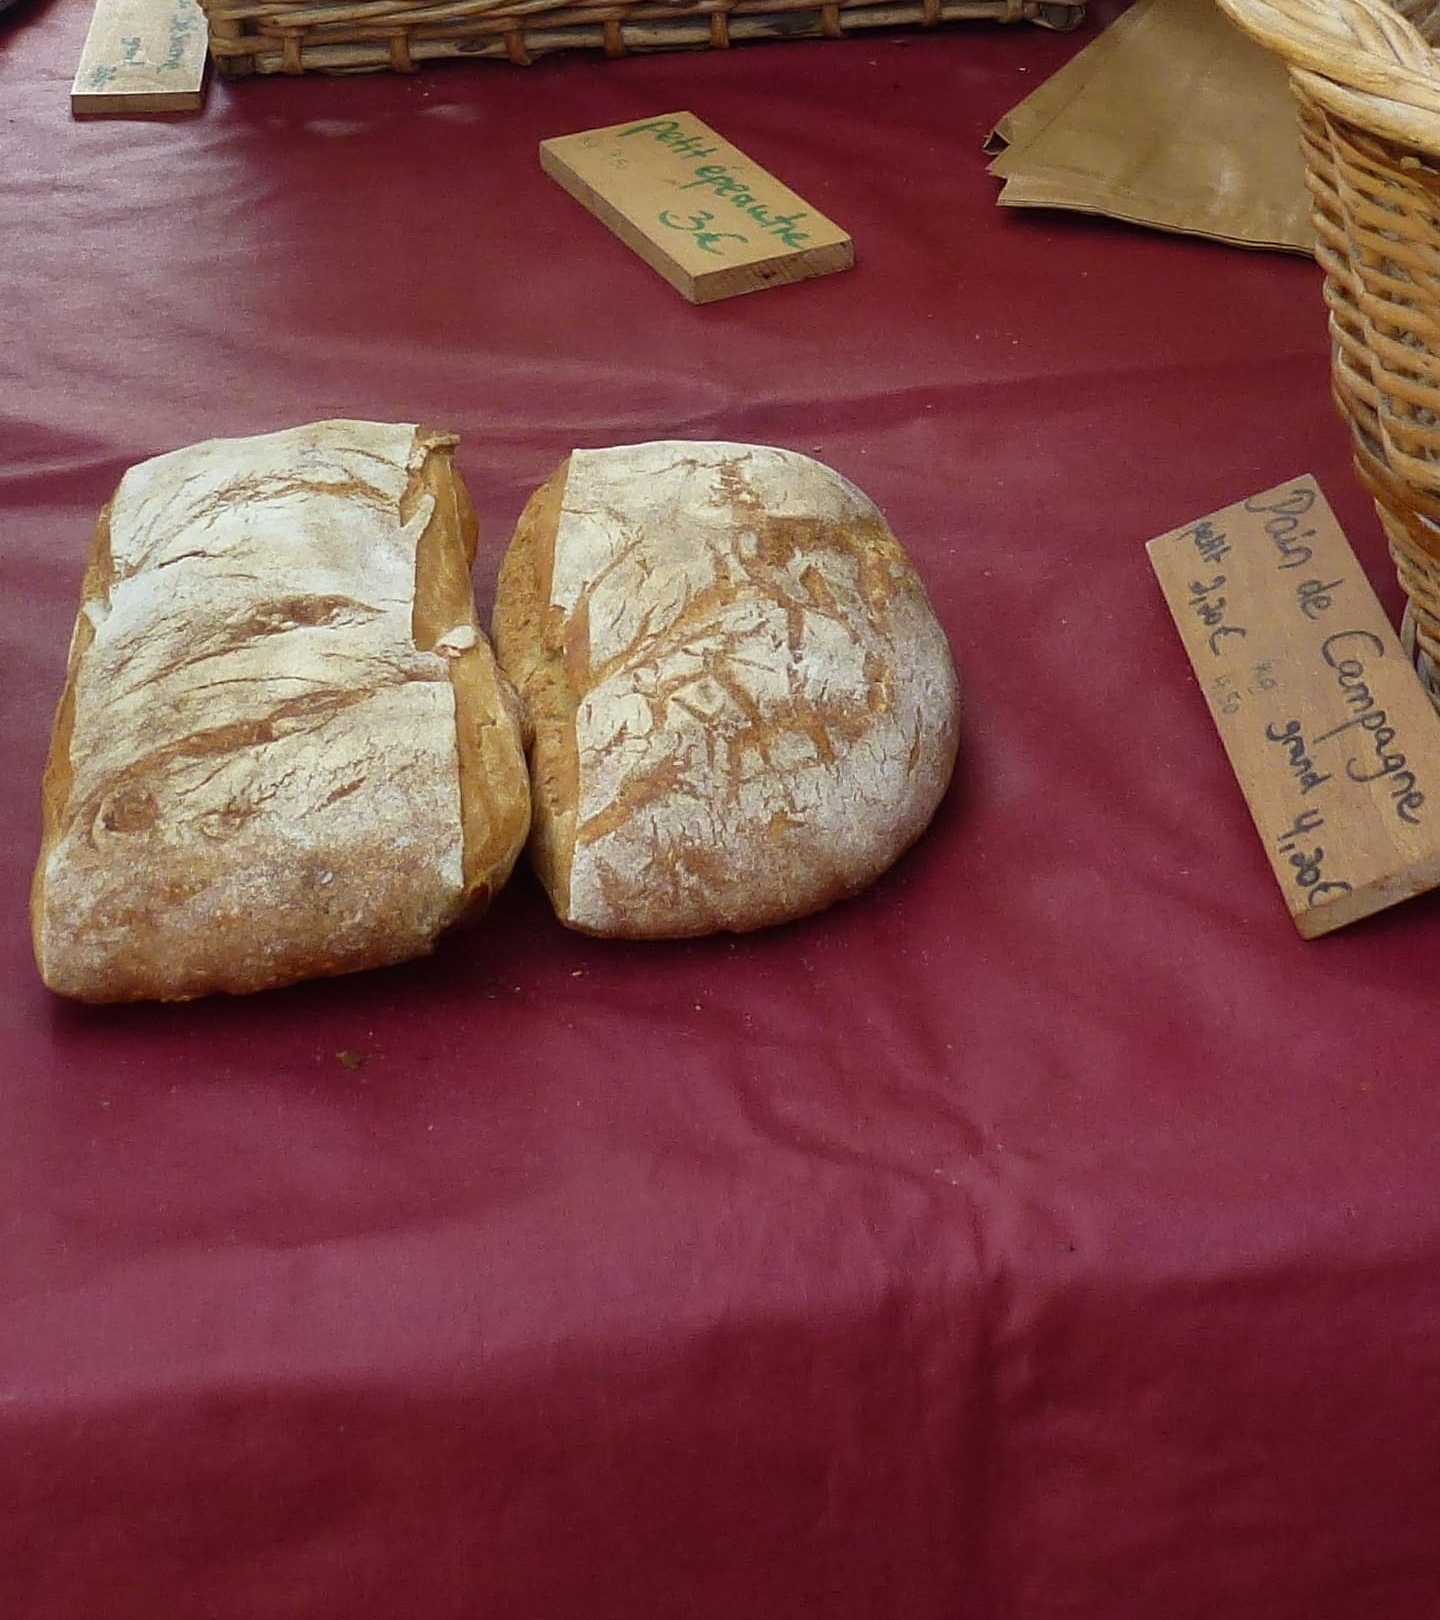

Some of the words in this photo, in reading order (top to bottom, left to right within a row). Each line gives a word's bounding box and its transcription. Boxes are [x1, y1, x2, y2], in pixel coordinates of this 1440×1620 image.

[1245, 488, 1316, 571] Pain
[1295, 577, 1346, 621] de
[1265, 719, 1334, 797] grand
[1312, 629, 1431, 825] Campagne
